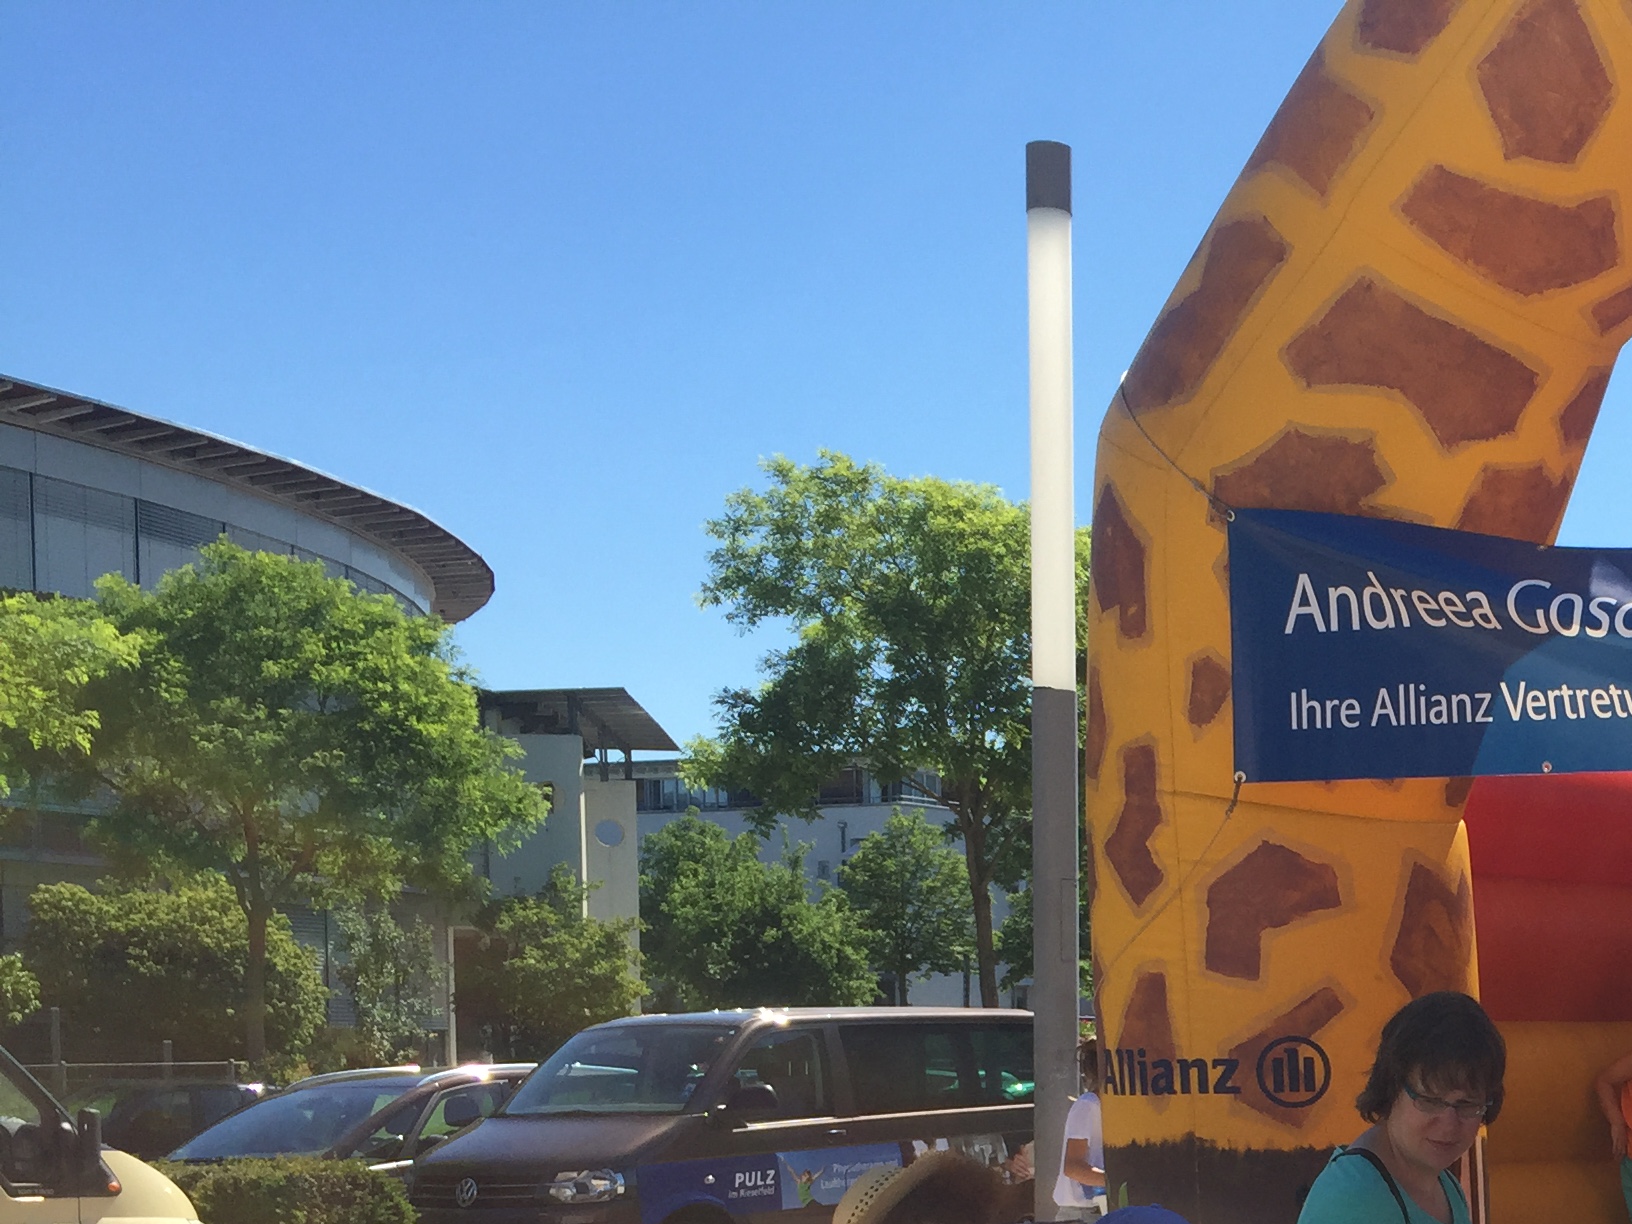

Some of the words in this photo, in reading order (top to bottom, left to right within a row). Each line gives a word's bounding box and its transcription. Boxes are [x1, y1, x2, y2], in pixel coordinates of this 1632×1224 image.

[1284, 570, 1502, 635] Andreea
[1289, 689, 1361, 731] Ihre
[1370, 683, 1494, 729] Allianz
[1103, 1048, 1242, 1097] Allianz
[735, 1169, 775, 1188] PULZ
